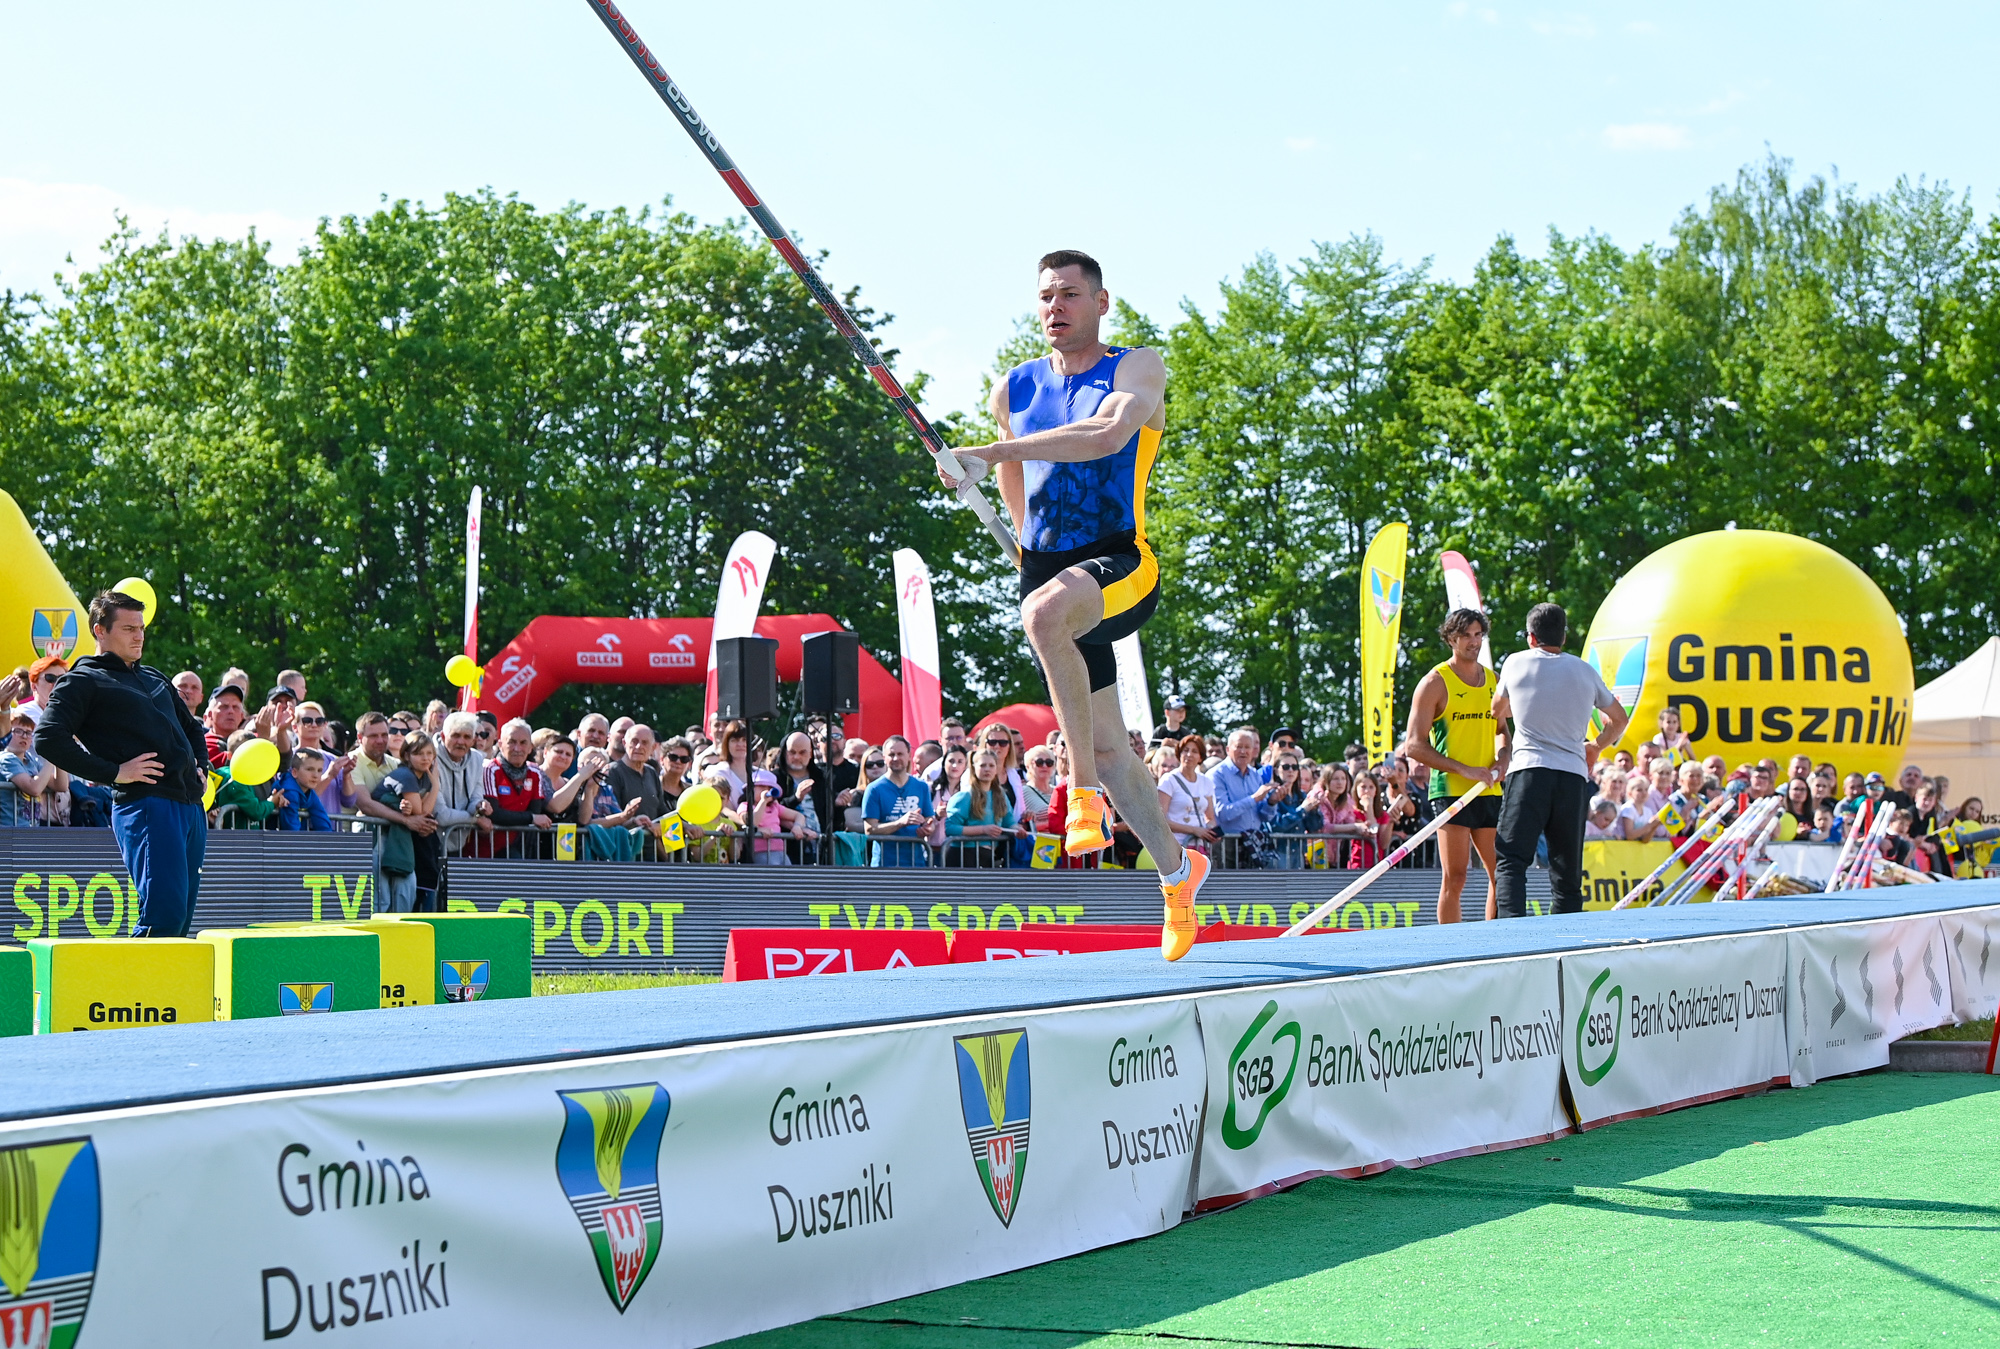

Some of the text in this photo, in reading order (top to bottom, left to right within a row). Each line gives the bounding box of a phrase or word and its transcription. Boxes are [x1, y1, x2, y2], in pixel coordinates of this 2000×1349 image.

[499, 666, 533, 699] ORLEN
[578, 654, 620, 664] ORLEN
[651, 655, 692, 664] ORLEN
[1668, 633, 1870, 683] Gmina
[1667, 694, 1908, 746] Duszniki
[88, 1002, 177, 1022] Gmina
[1587, 1012, 1614, 1047] SGB
[1631, 992, 1664, 1038] Bank
[1667, 984, 1741, 1042] Spółdzielczy
[1108, 1034, 1178, 1087] Gmina
[1307, 1009, 1561, 1092] Bank Spółdzielczy Dusznik
[1237, 1055, 1274, 1101] SGB
[769, 1082, 870, 1146] Gmina
[1102, 1103, 1198, 1170] Duszniki
[278, 1139, 430, 1216] Gmina
[767, 1163, 893, 1243] Duszniki
[261, 1239, 449, 1341] Duszniki
